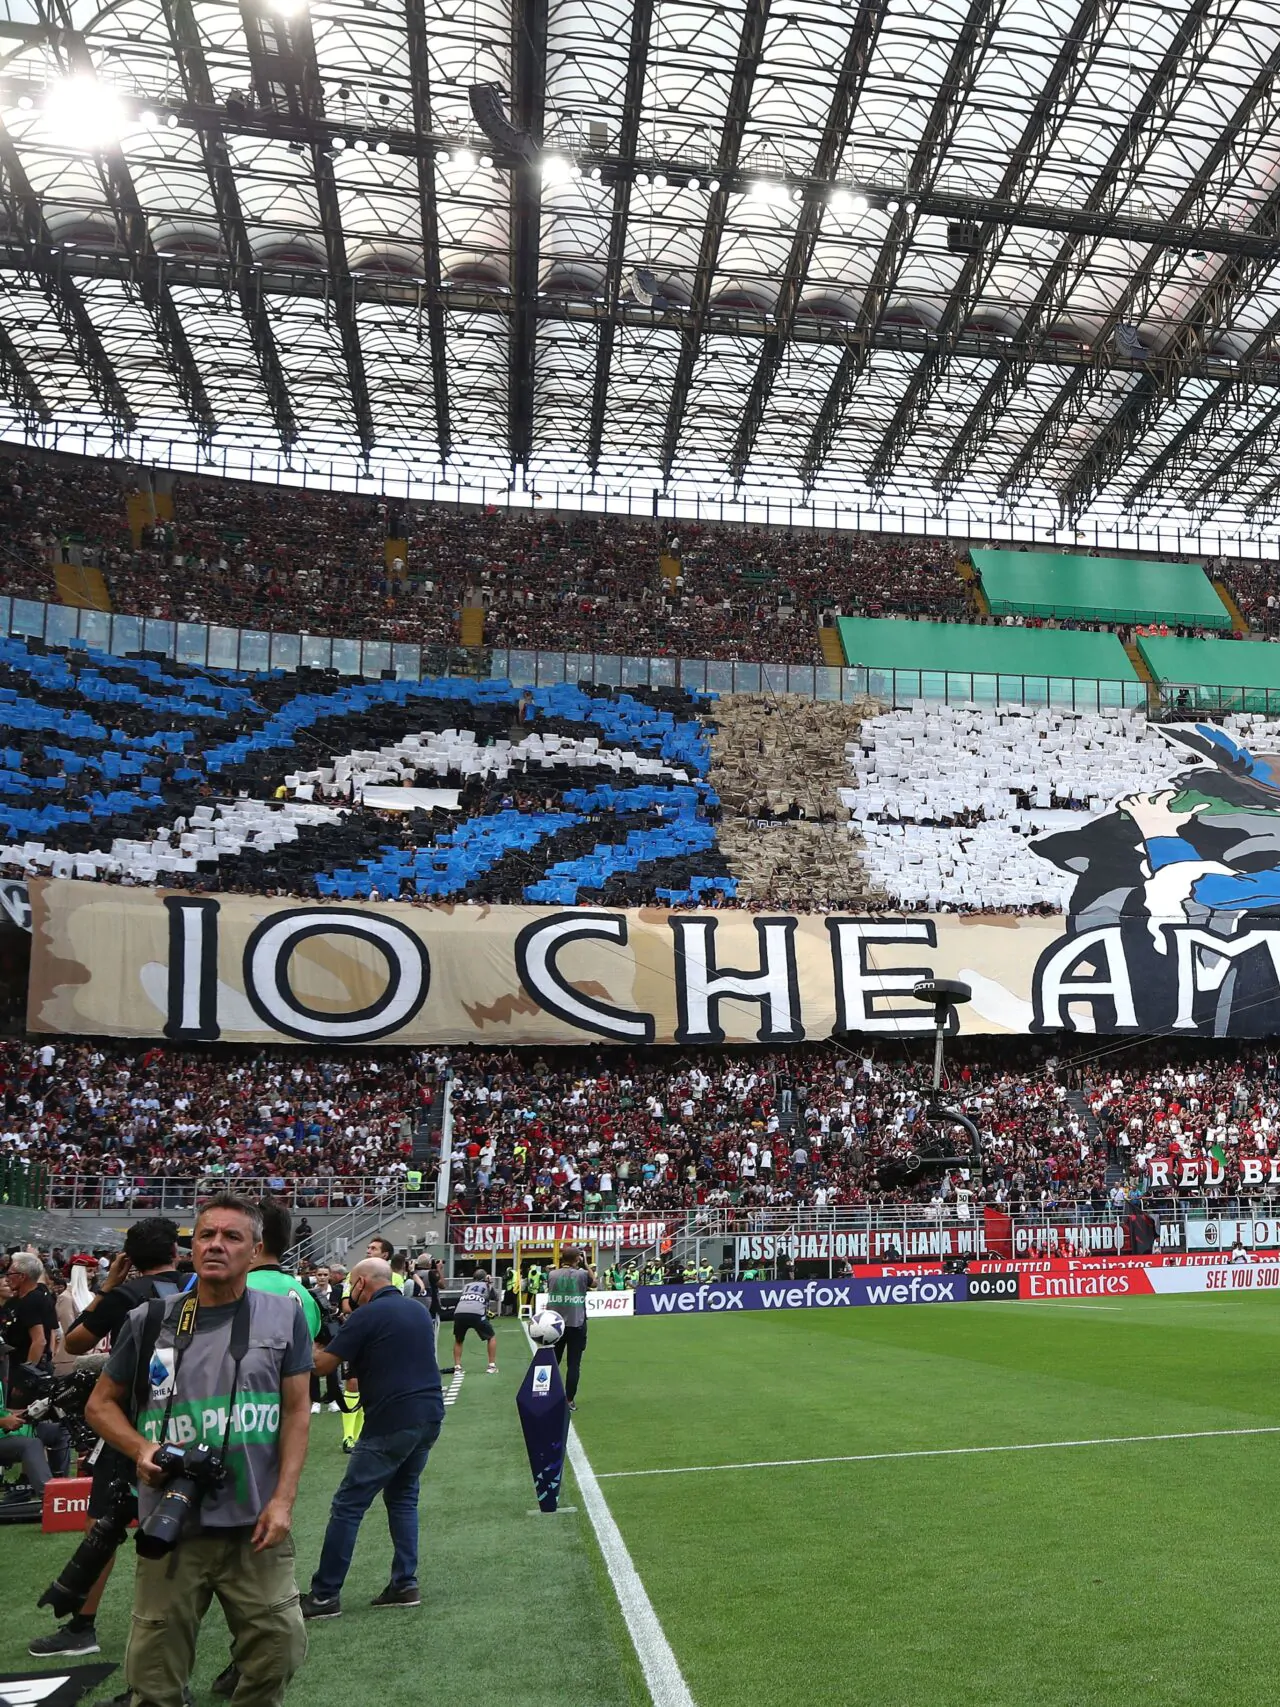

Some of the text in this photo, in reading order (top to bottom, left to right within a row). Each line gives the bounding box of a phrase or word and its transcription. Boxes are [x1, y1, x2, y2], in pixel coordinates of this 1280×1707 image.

[163, 896, 430, 1043] IO
[515, 911, 959, 1044] CHE
[1151, 1156, 1225, 1187] RED
[464, 1226, 504, 1250] CASA
[508, 1225, 556, 1249] MILAN
[572, 1224, 624, 1248] JUNIOR
[739, 1233, 868, 1260] ASSOCIAZIONE
[874, 1230, 952, 1256] ITALIANA
[1016, 1228, 1059, 1251] CLUB
[1064, 1226, 1125, 1250] MONDO
[968, 1279, 1017, 1294] 00:00
[1029, 1273, 1129, 1296] Emirates
[1206, 1271, 1228, 1288] SEE
[1232, 1269, 1253, 1287] YOU
[548, 1295, 563, 1303] LUB
[588, 1298, 630, 1311] SPACT
[651, 1277, 954, 1312] wefox wefox wefox
[202, 1403, 280, 1439] PHOTO
